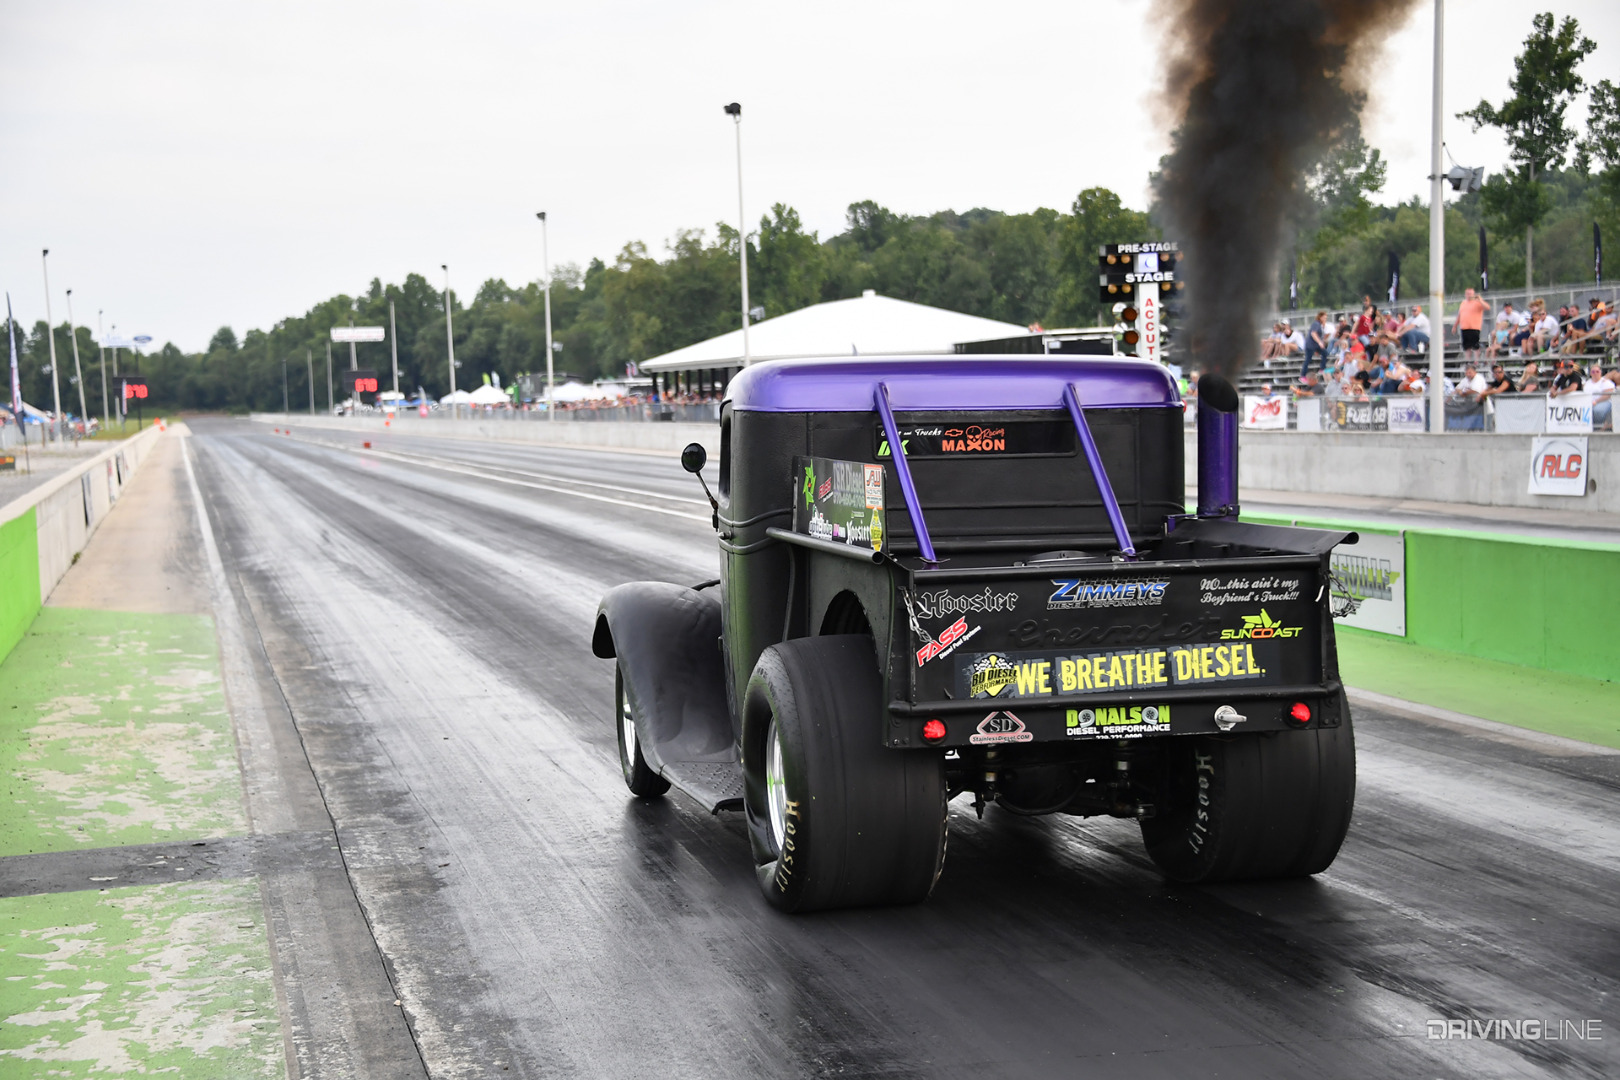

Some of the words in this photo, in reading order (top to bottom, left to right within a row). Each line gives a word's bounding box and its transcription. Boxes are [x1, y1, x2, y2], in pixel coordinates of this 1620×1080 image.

[1117, 243, 1178, 254] PRE-STAGE
[1125, 272, 1174, 283] STAGE
[915, 428, 942, 437] Trucks
[982, 428, 1005, 439] Racing
[942, 439, 1005, 452] MAXON
[1540, 454, 1583, 478] RLC
[1251, 577, 1280, 589] ain't
[1281, 579, 1299, 591] my
[1048, 579, 1170, 604] ZIMMEYS
[1260, 591, 1300, 603] Truck!!!
[917, 586, 1019, 619] Hoosier
[1047, 602, 1085, 611] DIESEL
[1087, 599, 1163, 609] PERFORMANCE
[1220, 627, 1304, 640] SUNCOAST
[916, 615, 968, 667] FASS
[1014, 662, 1052, 696] WE
[1059, 651, 1168, 692] BREATHE
[1173, 644, 1267, 682] DIESEL.
[972, 672, 986, 687] BD
[987, 668, 1018, 681] DIESEL
[971, 678, 1017, 697] PERFORMANCE
[1066, 705, 1171, 728] DONALSON
[989, 718, 1014, 733] SD
[1066, 726, 1100, 736] DIESEL
[1103, 723, 1171, 734] PERFORMANCE
[775, 799, 802, 893] Hoosier
